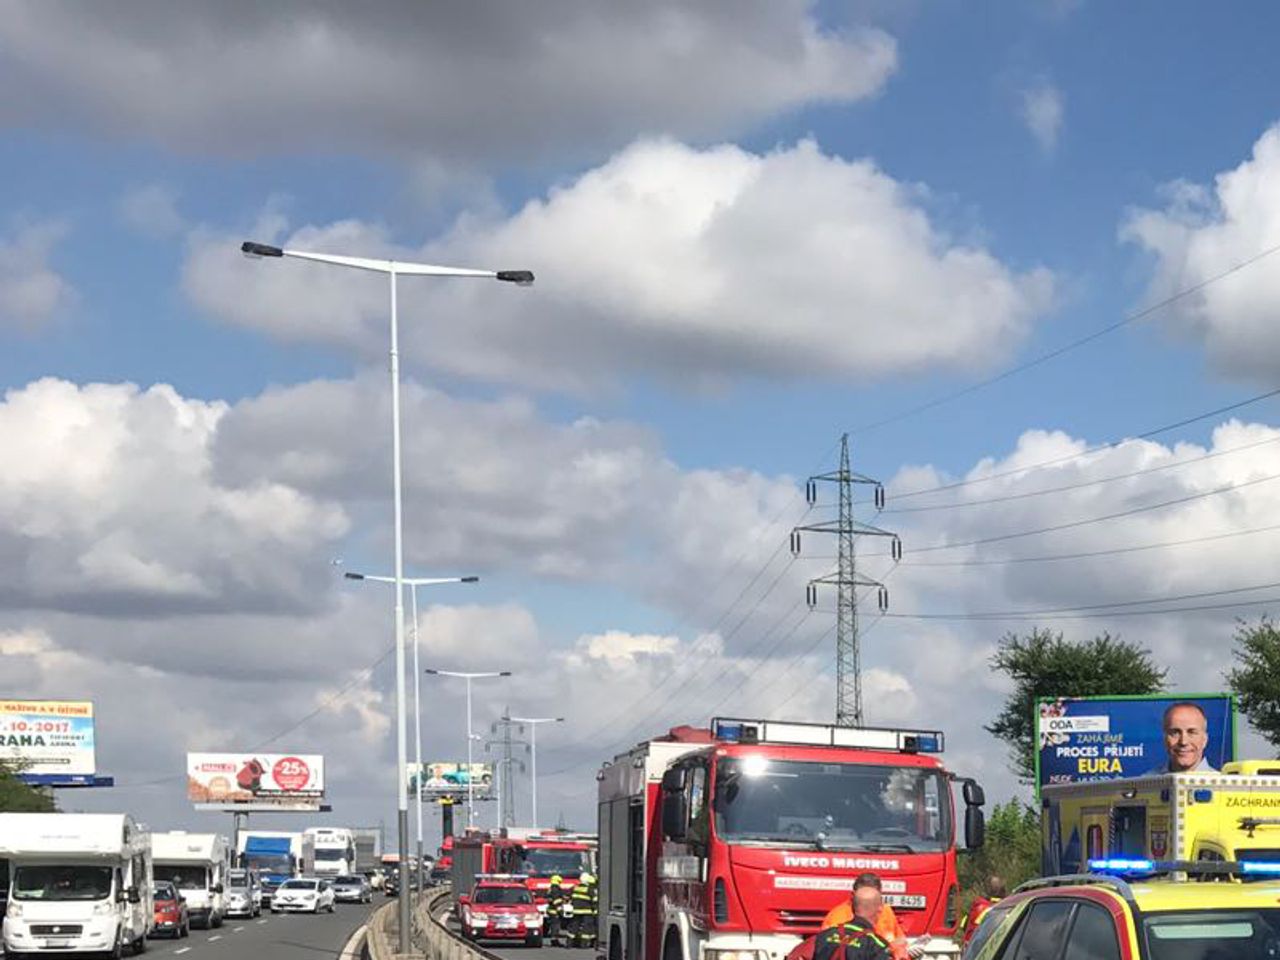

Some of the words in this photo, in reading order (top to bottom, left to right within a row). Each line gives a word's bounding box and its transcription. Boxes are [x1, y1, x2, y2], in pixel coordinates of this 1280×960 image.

[1049, 719, 1073, 730] ODA
[1056, 745, 1099, 758] PROCES
[1103, 742, 1144, 758] PŘIJETÍ
[1078, 758, 1123, 774] EURA
[783, 856, 830, 868] IVECO
[832, 858, 899, 870] MAGIRUS
